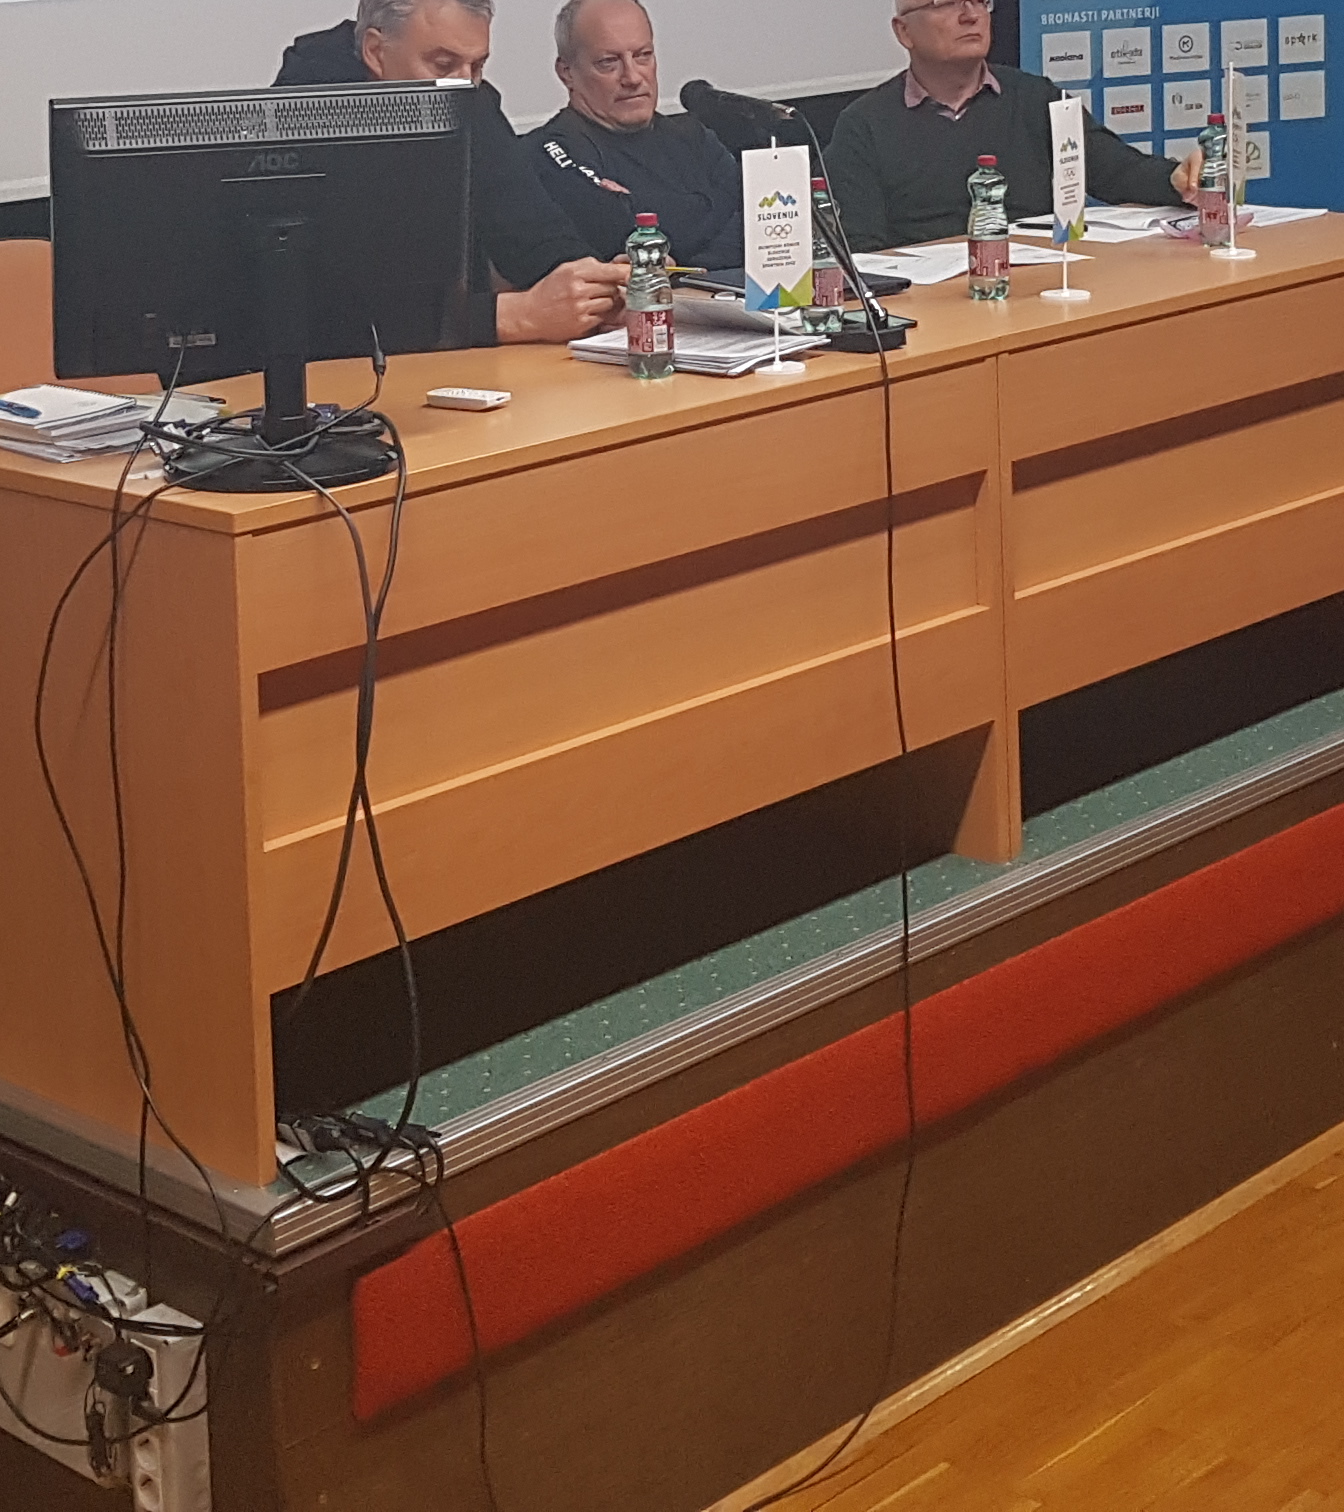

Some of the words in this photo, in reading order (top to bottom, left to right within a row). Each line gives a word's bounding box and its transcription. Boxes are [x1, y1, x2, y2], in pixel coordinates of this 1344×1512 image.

[1041, 11, 1097, 25] BRONASTI
[1101, 6, 1160, 21] PARTNERJI
[247, 151, 300, 173] AOC
